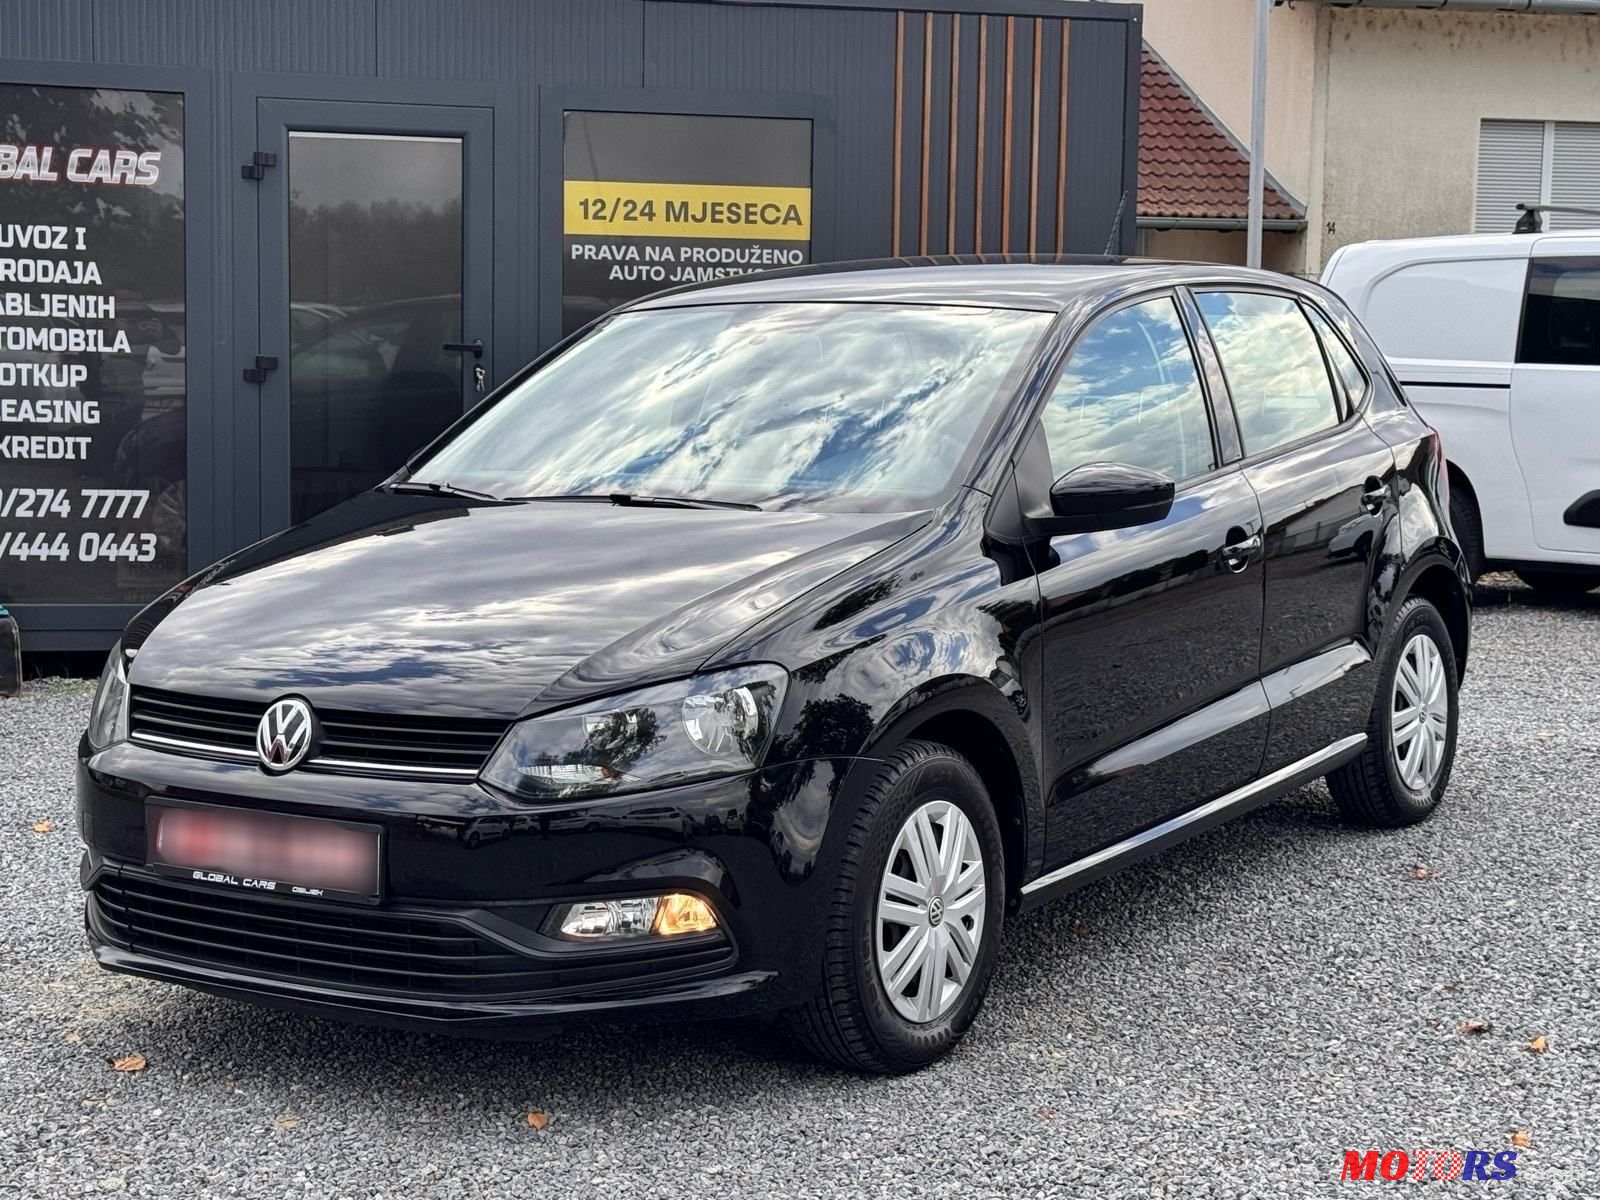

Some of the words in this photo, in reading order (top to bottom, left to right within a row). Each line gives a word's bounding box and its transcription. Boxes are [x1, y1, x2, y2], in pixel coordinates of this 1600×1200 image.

[66, 148, 162, 186] CARS
[579, 197, 657, 223] 12/24
[665, 200, 803, 226] MJESECA
[0, 224, 68, 250] UVOZ
[75, 227, 87, 250] I
[571, 244, 641, 261] PRAVA
[645, 246, 676, 262] NA
[680, 245, 804, 265] PRODUŽENO
[608, 265, 666, 282] AUTO
[669, 266, 764, 282] JAMST
[0, 362, 88, 388] OTKUP
[0, 399, 101, 424] EASING
[0, 487, 71, 518] /274
[81, 489, 150, 519] 7777
[78, 532, 158, 562] 0443
[192, 871, 239, 885] GLOBAL
[242, 878, 277, 890] CARS
